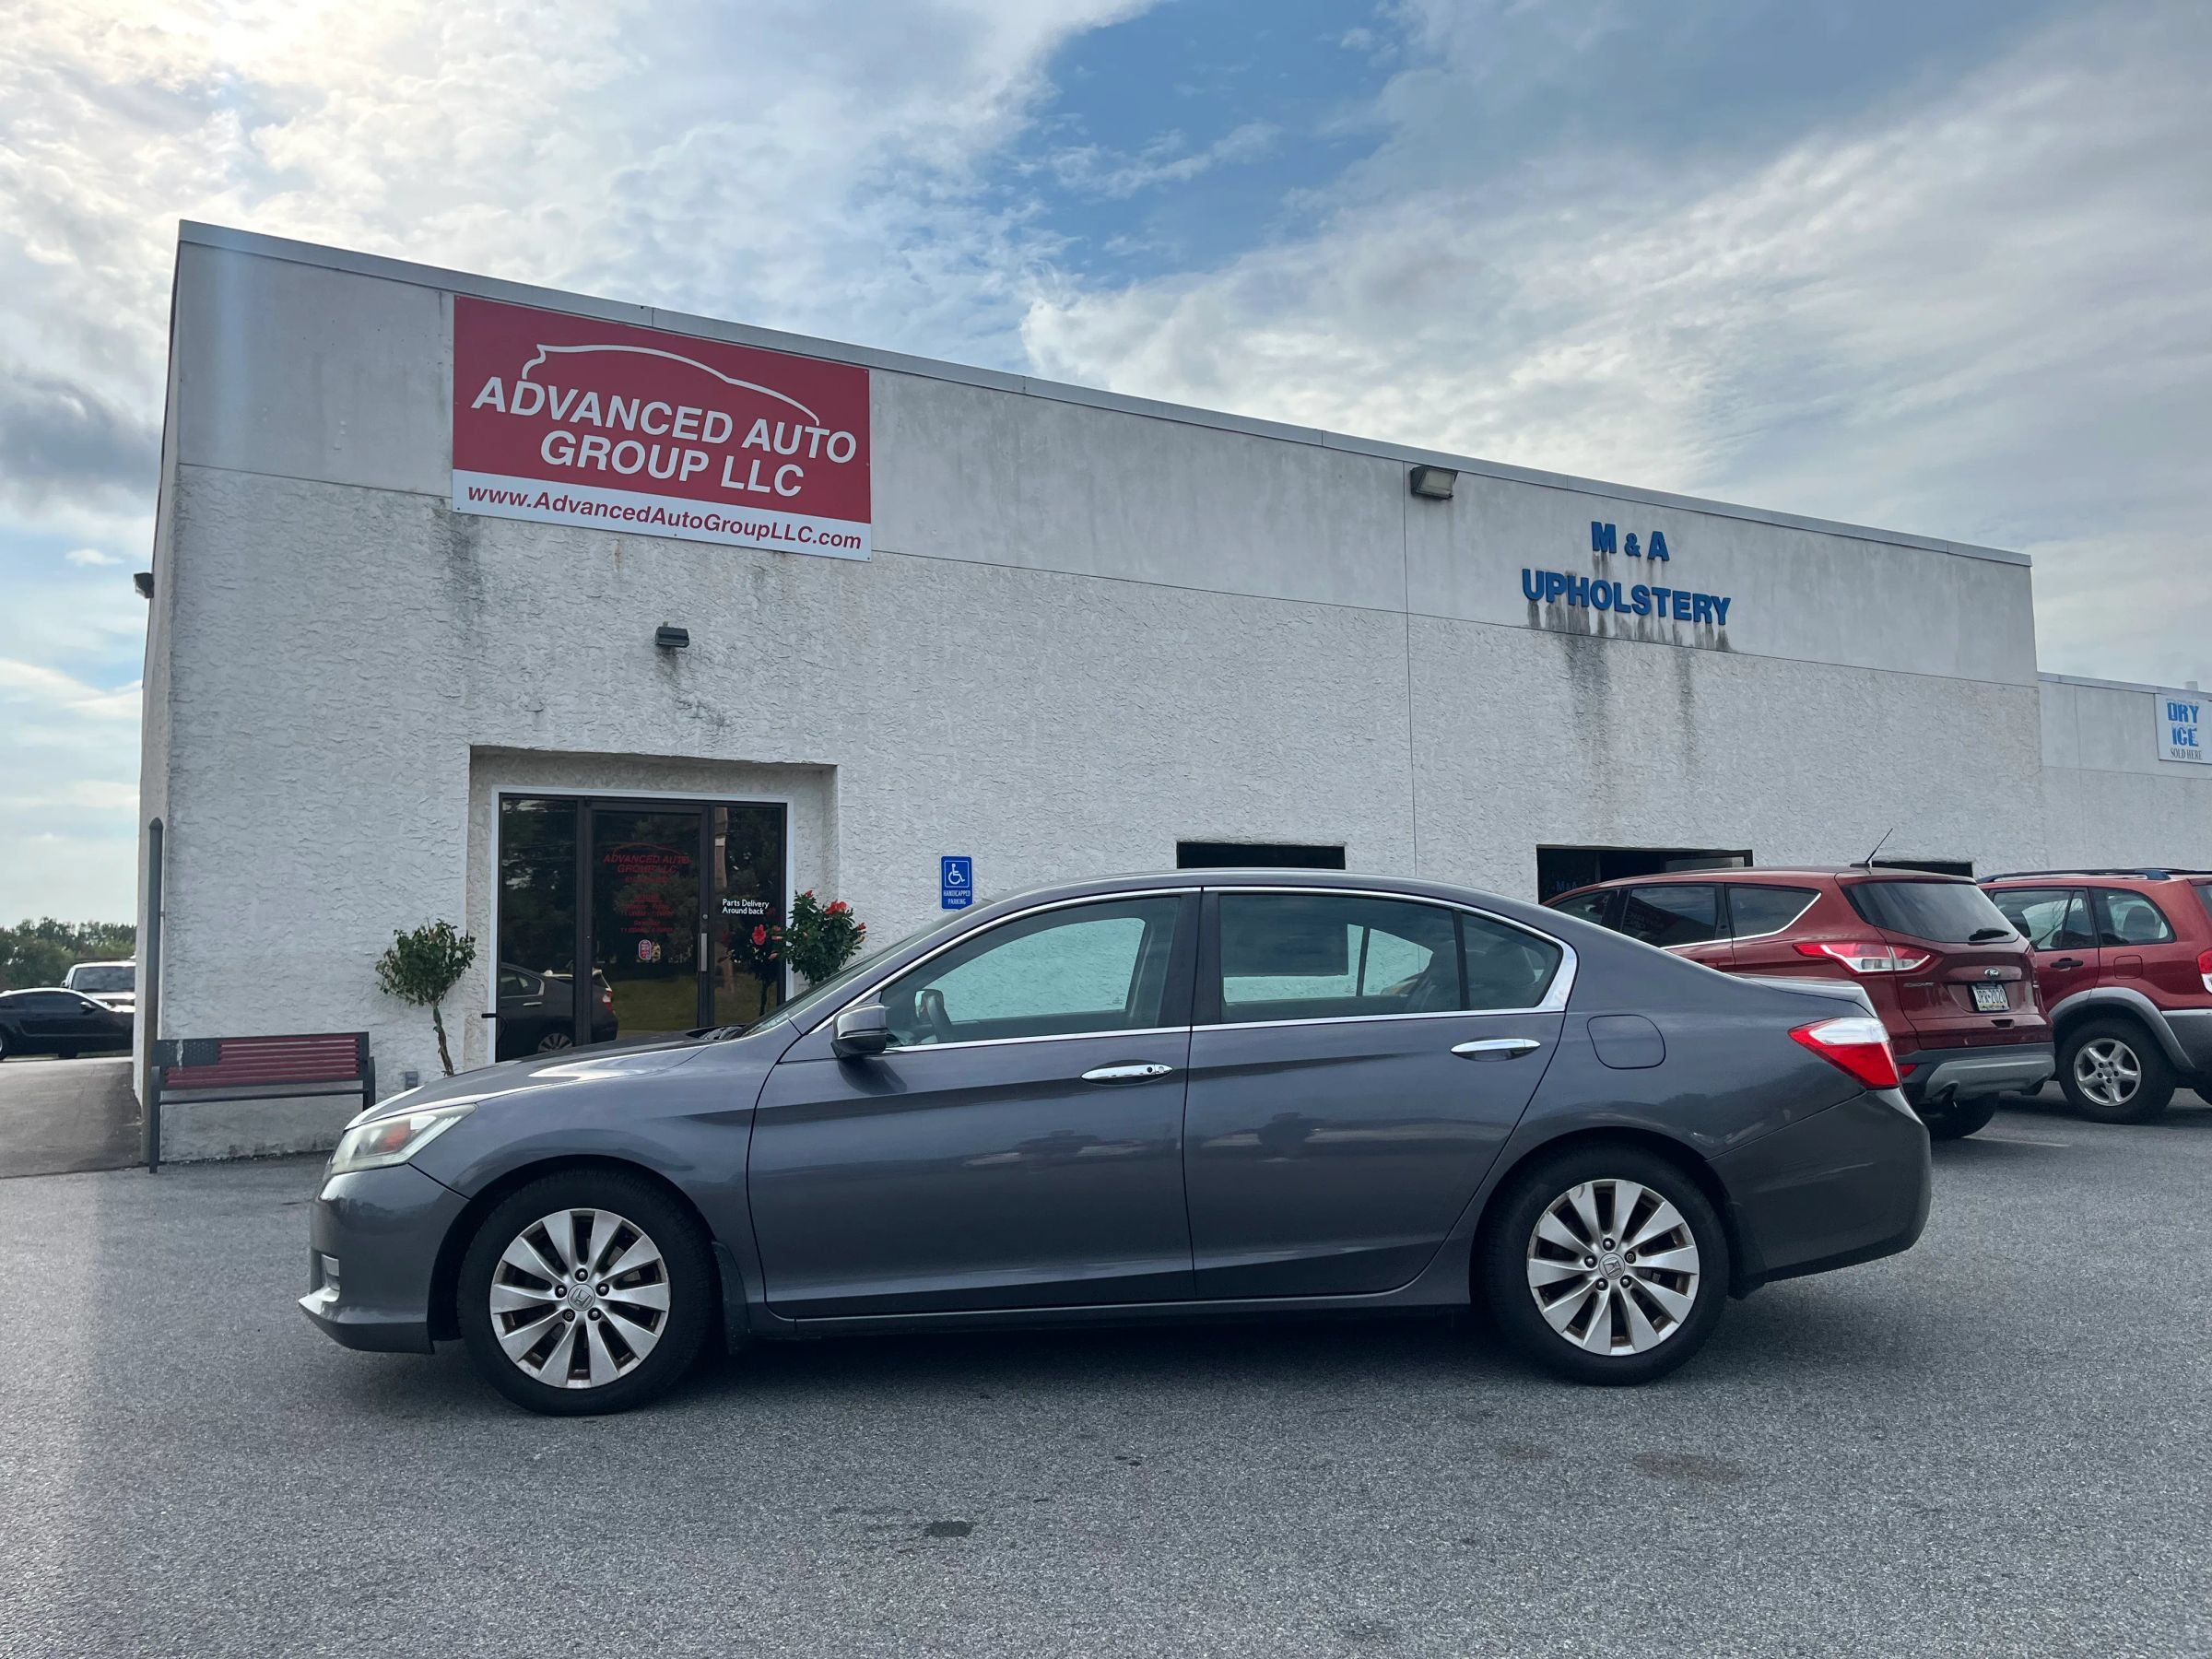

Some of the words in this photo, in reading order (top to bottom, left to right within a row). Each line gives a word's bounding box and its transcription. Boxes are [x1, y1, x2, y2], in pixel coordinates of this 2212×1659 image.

[471, 376, 733, 444] ADVANCED
[741, 418, 856, 464] AUTO
[540, 430, 709, 482] GROUP
[721, 455, 805, 497] LLC
[467, 486, 862, 550] www.AdvancedAutoGroupLLC.com
[1591, 521, 1618, 554] M
[1624, 533, 1641, 558] &
[1647, 531, 1670, 561] A
[1522, 569, 1731, 626] UPHOLSTERY
[2167, 702, 2199, 724] DRY
[2171, 727, 2199, 747] ICE
[2170, 747, 2186, 759] SOLD
[2186, 749, 2203, 760] HERE
[604, 854, 660, 864] ADVANCED
[722, 898, 740, 907] Parts
[741, 899, 770, 910] Delivery
[722, 906, 747, 914] Around
[748, 907, 764, 915] back
